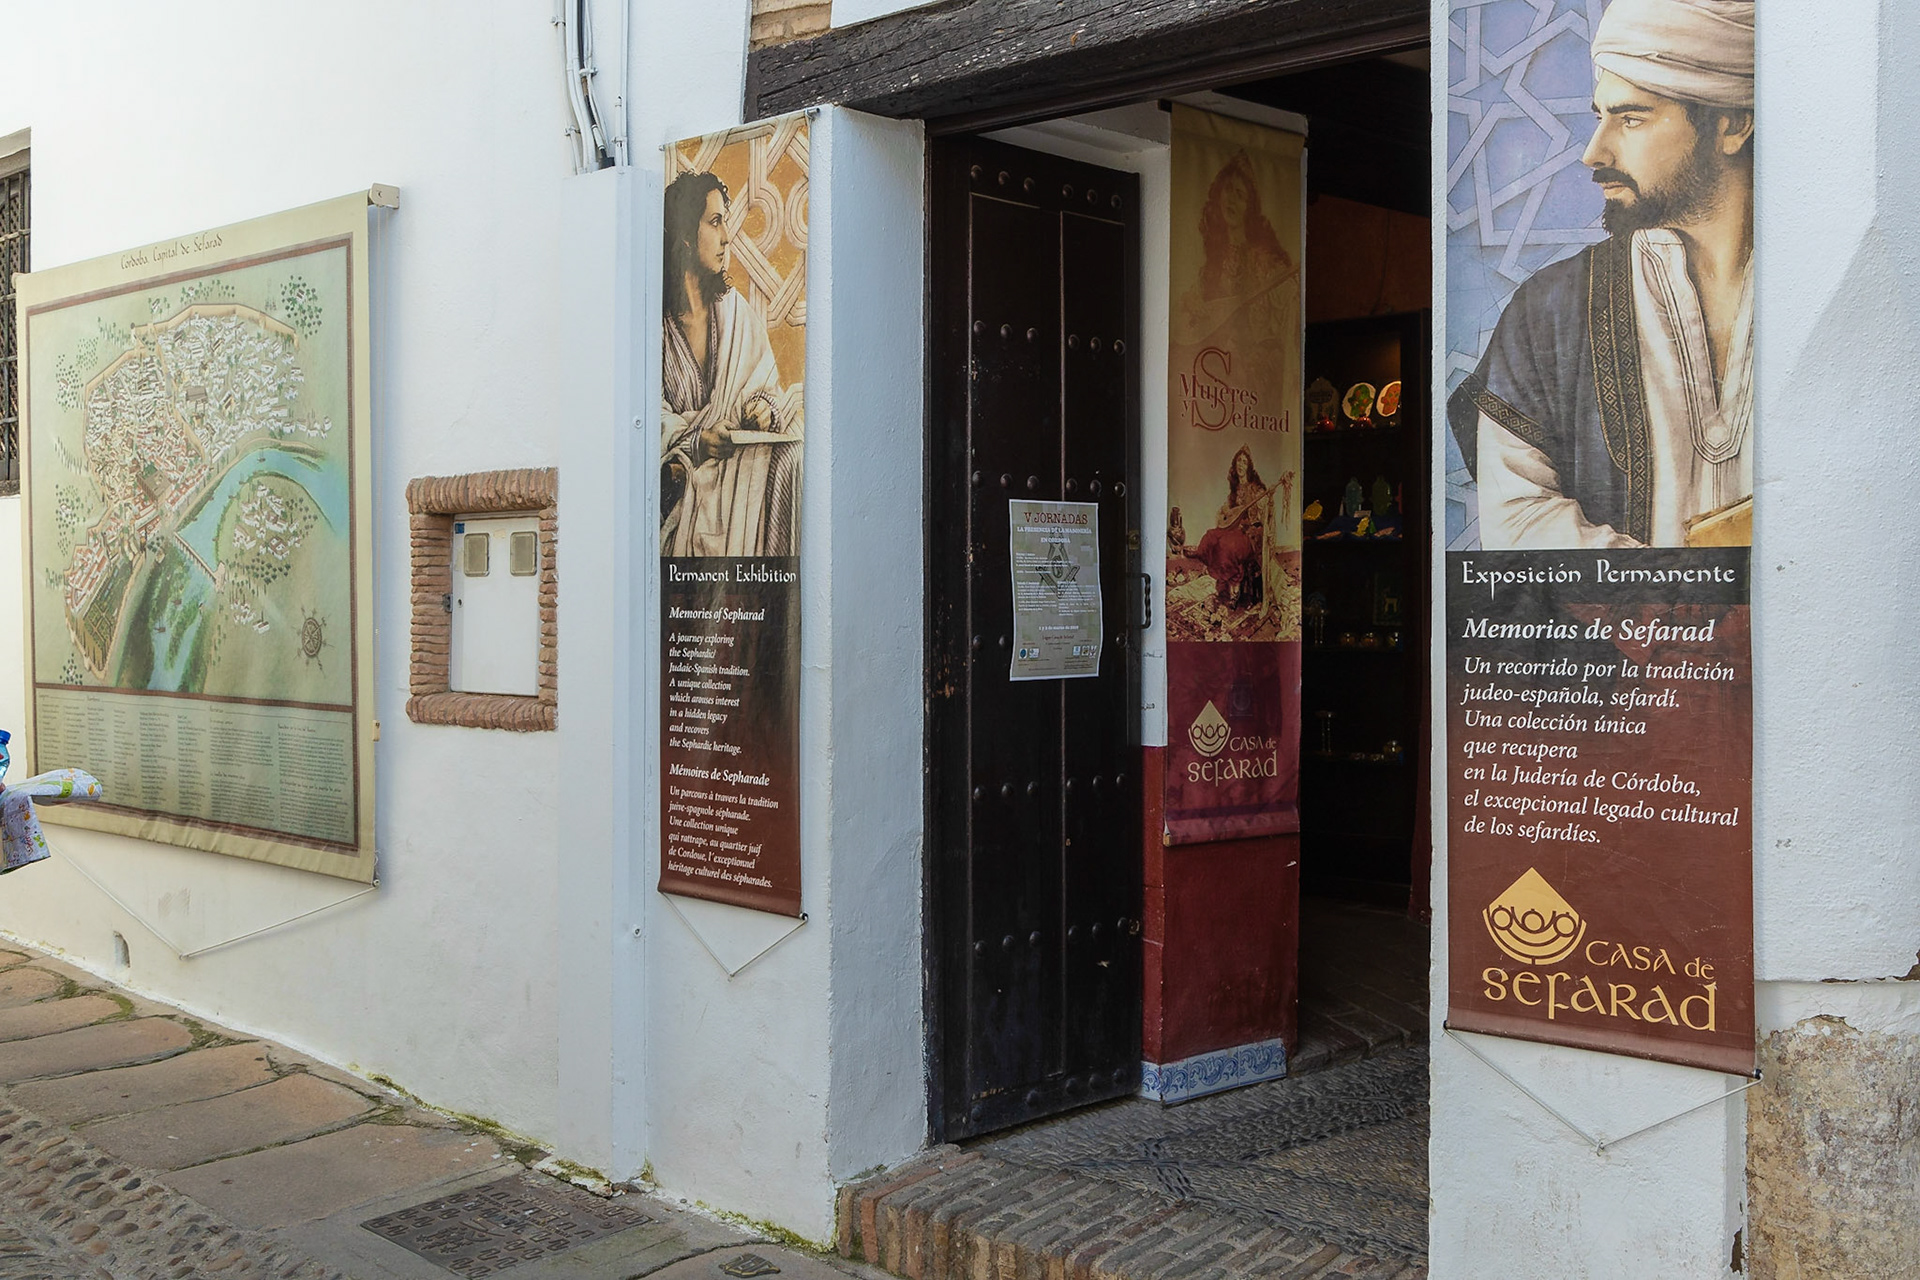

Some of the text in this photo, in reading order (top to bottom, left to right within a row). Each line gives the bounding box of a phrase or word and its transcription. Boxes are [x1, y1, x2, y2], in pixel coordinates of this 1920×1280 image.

[1180, 373, 1258, 409] Mujeres
[1024, 512, 1088, 524] V JORNADAS
[669, 563, 796, 582] Permanent Exhibition
[1462, 559, 1736, 600] Exposición Permanente
[669, 607, 765, 624] Memories of Sepharad
[668, 633, 734, 648] A journey exploring
[1462, 618, 1716, 647] Memorias de Sefarad
[669, 647, 682, 657] the
[668, 662, 750, 676] Judaic-Spanish tradition.
[1464, 656, 1735, 682] Un recorrido por la tradición
[668, 678, 732, 690] A unique collection
[670, 692, 740, 707] which arouses interest
[1460, 683, 1680, 712] judeo-española, sefardí.
[670, 708, 728, 724] in a hidden legacy
[1464, 710, 1647, 735] Una colección única
[669, 722, 710, 735] and recovers
[669, 737, 742, 756] the Sephardic heritage.
[1230, 736, 1276, 752] CASA de
[1463, 740, 1578, 764] que recupera
[669, 764, 770, 786] Mémoires de Sepharade
[1464, 764, 1702, 797] en la Judería de Córdoba,
[670, 786, 779, 809] Un parcours à travers la tradition
[1464, 789, 1740, 827] el excepcional legado cultural
[715, 807, 751, 821] sépharade.
[670, 816, 739, 836] Une collection unique
[1464, 816, 1602, 844] de los sefardíes.
[668, 832, 762, 858] qui rattrape, au quartier juif
[668, 846, 677, 856] de
[677, 848, 707, 862] Cordoue,
[668, 860, 773, 888] héritage culturel des sépharades.
[1585, 940, 1716, 980] CASA de
